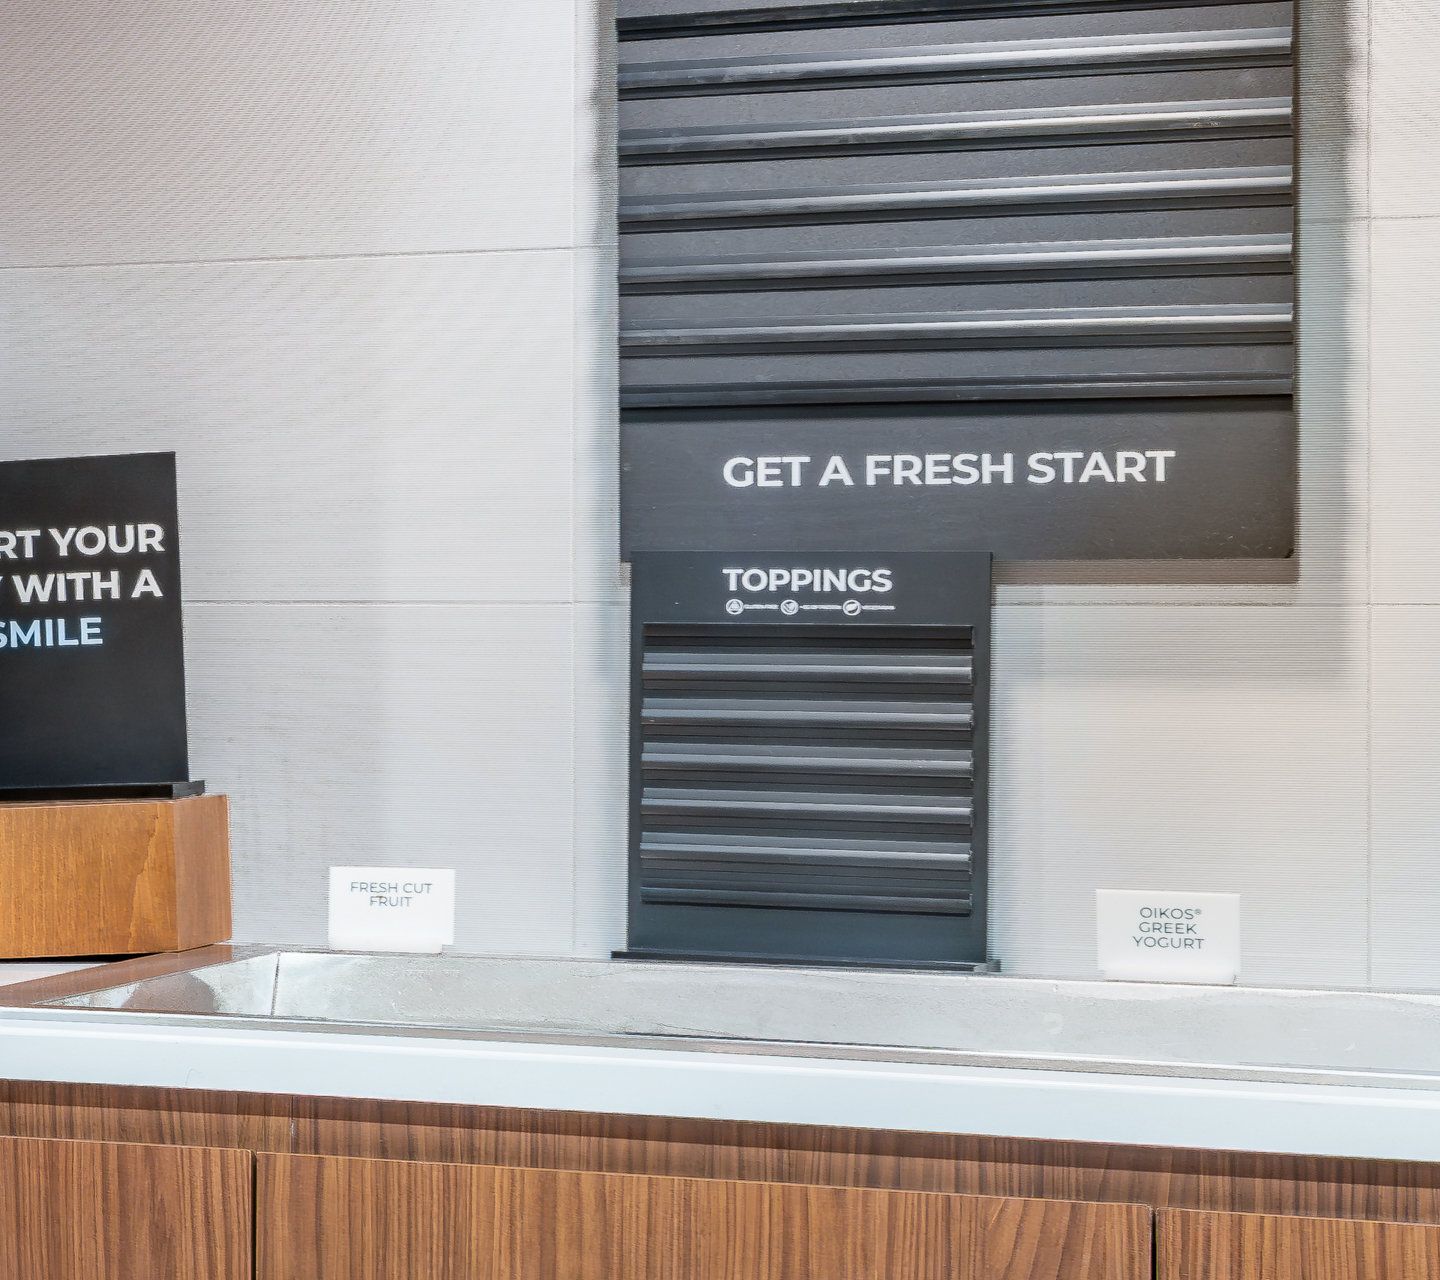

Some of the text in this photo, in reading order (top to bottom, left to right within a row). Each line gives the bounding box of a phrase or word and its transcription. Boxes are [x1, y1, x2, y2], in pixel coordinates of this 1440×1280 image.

[722, 450, 1176, 487] GET A FRESH START
[48, 523, 165, 557] YOUR
[13, 570, 120, 603] WITH
[130, 569, 163, 599] A
[722, 568, 894, 592] TOPPINGS
[350, 881, 433, 894] FRESH CUT
[369, 896, 413, 907] FRUIT
[1138, 922, 1197, 934] GREEK
[1132, 936, 1205, 949] YOGURT
